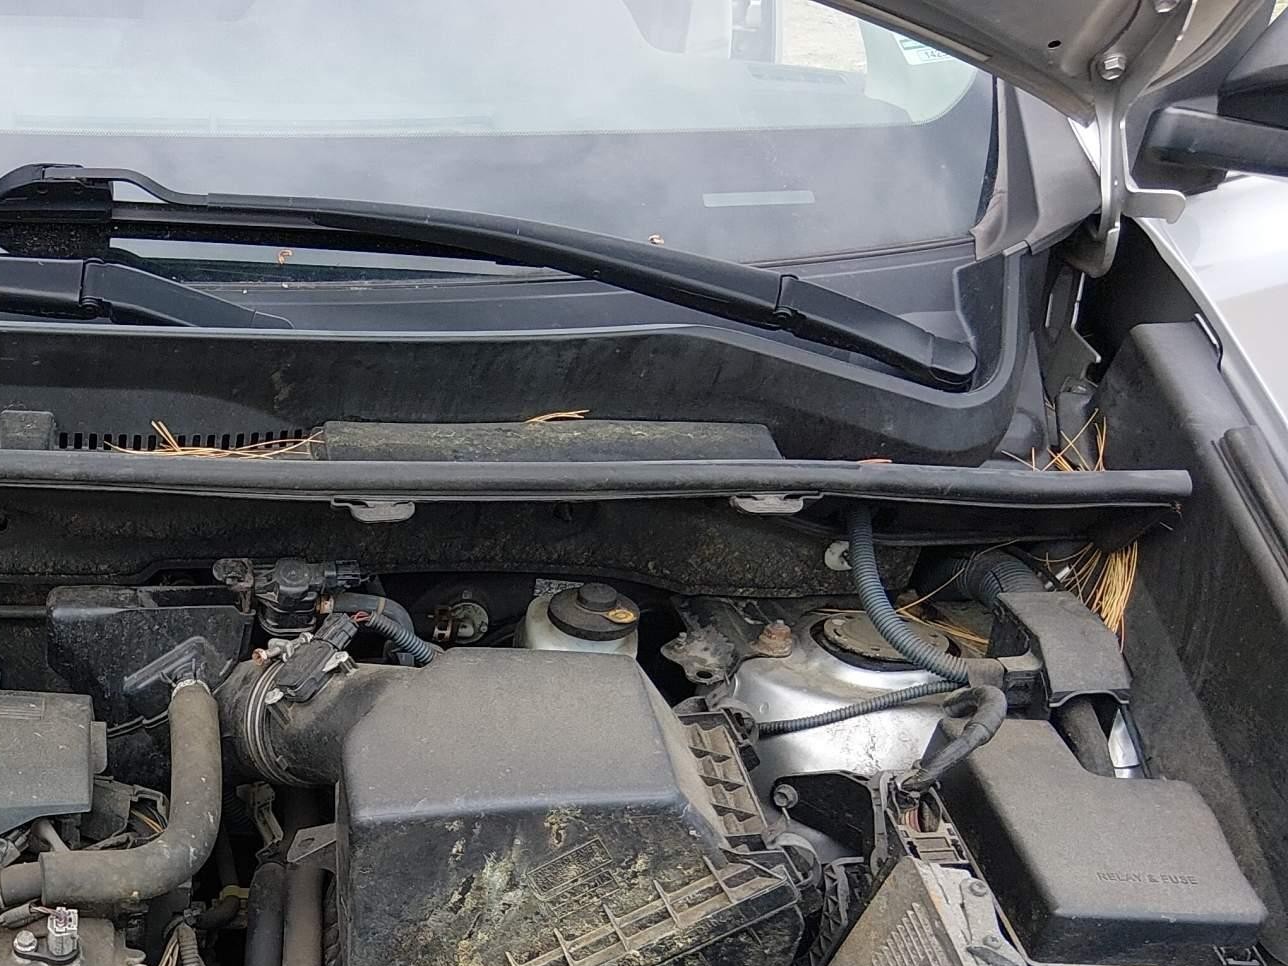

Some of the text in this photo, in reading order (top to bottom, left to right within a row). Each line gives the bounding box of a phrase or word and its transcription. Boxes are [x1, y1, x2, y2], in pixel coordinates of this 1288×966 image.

[1096, 871, 1199, 885] RELAY & FUSE
